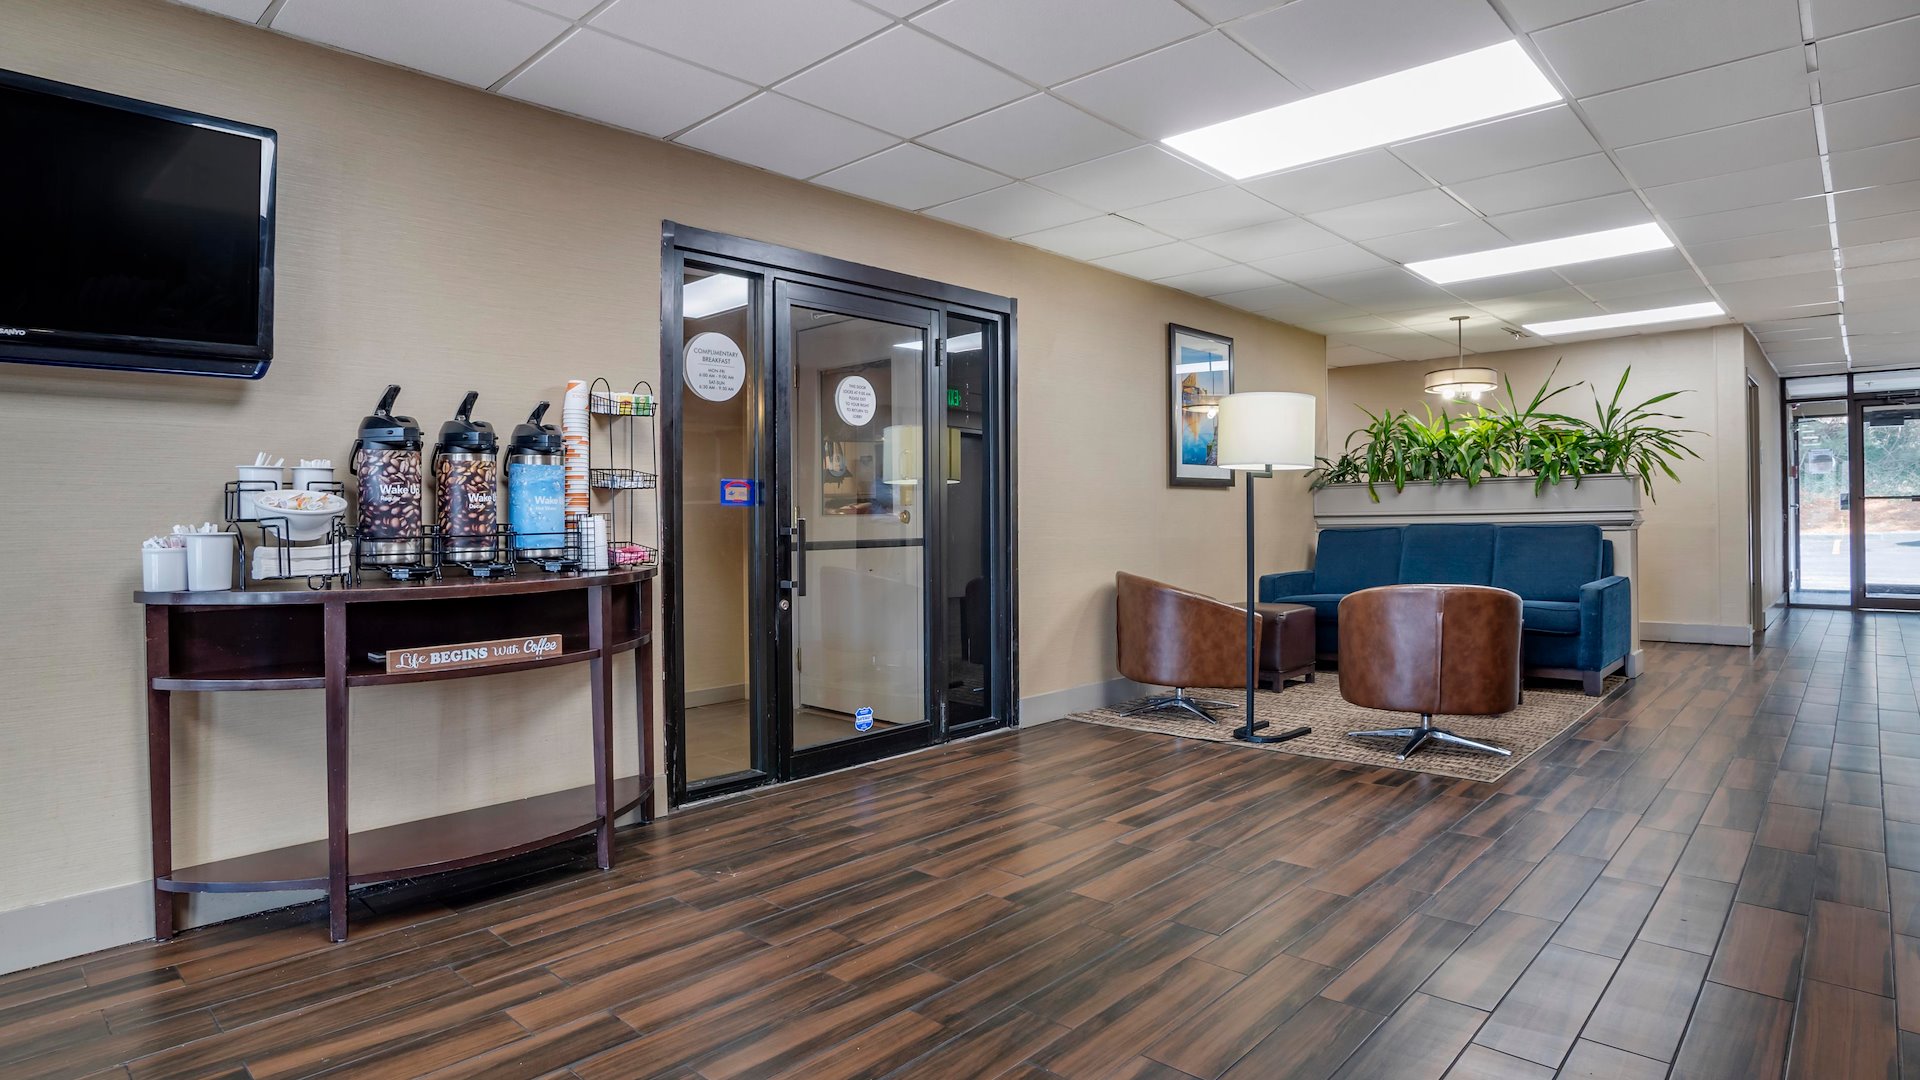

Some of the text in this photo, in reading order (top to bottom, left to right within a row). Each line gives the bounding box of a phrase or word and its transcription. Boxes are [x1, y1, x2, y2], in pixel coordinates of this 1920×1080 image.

[0, 328, 26, 336] SANYO
[693, 347, 739, 358] COMPLIMENTARY
[702, 356, 731, 365] BREAKFAST
[380, 483, 420, 496] Wake Up
[468, 492, 492, 503] Wake
[534, 495, 559, 505] Wake
[395, 637, 557, 669] Life BEGINS With Coffee
